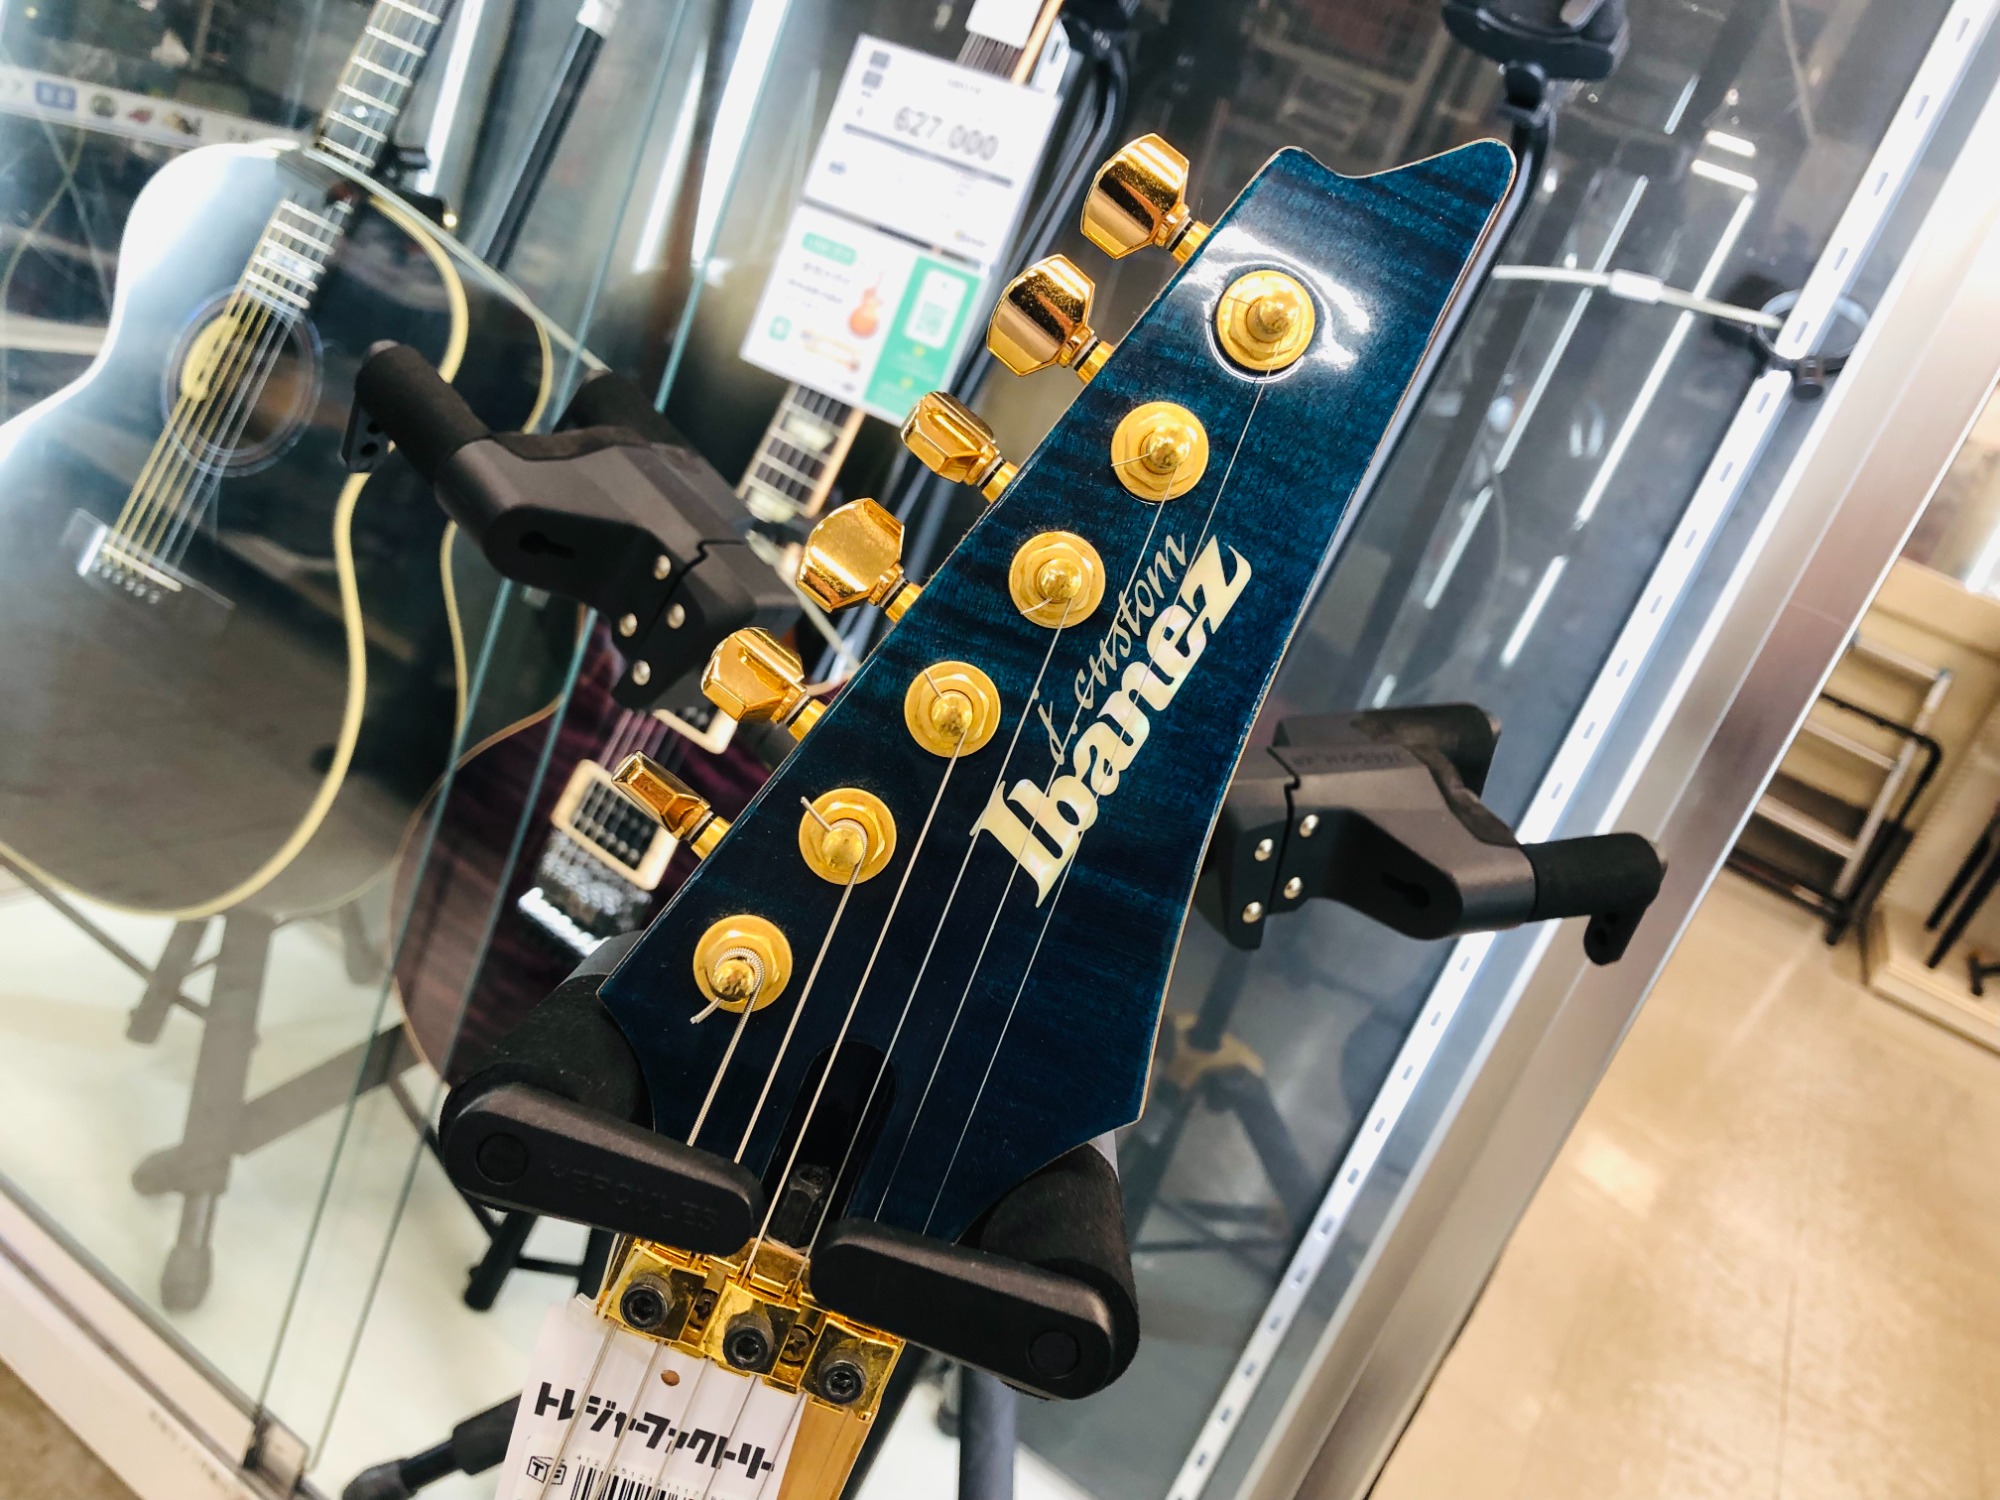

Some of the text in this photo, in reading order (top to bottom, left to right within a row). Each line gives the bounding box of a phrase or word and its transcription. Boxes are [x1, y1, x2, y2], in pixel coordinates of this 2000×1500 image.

[969, 534, 1252, 908] Ibanez
[535, 1382, 775, 1479] トレジャーファクトリー
